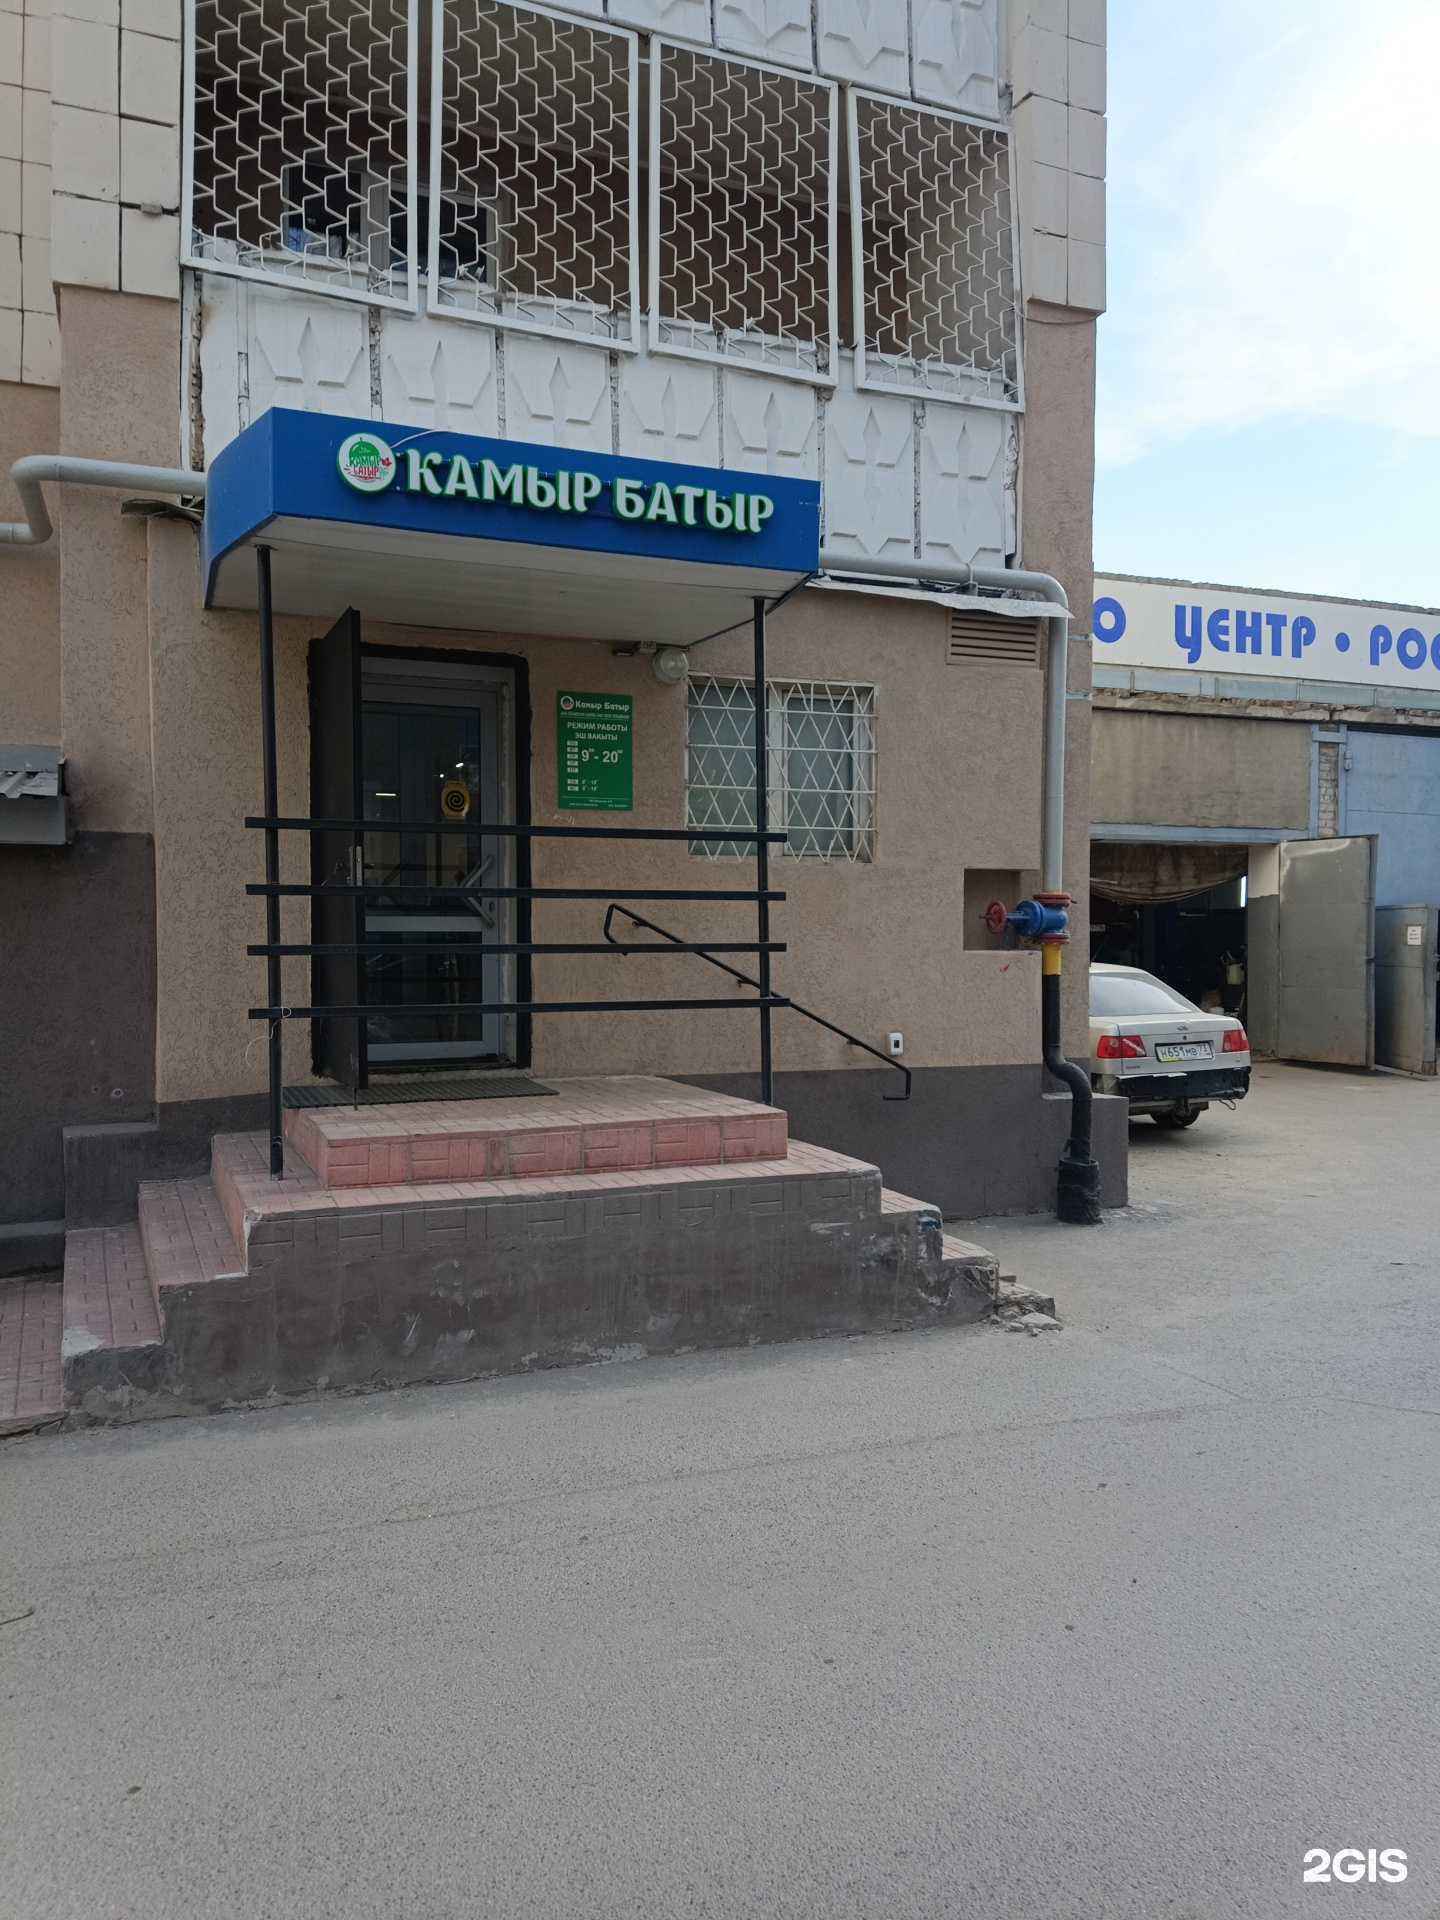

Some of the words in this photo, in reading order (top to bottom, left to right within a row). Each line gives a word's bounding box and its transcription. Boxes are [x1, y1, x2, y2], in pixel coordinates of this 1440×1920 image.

[405, 448, 602, 513] КАМЫР
[614, 477, 774, 534] БАТЫР
[1174, 603, 1316, 665] ЦЕНТР
[567, 721, 596, 730] РЕЖИМ
[597, 723, 628, 732] РАБОТЫ
